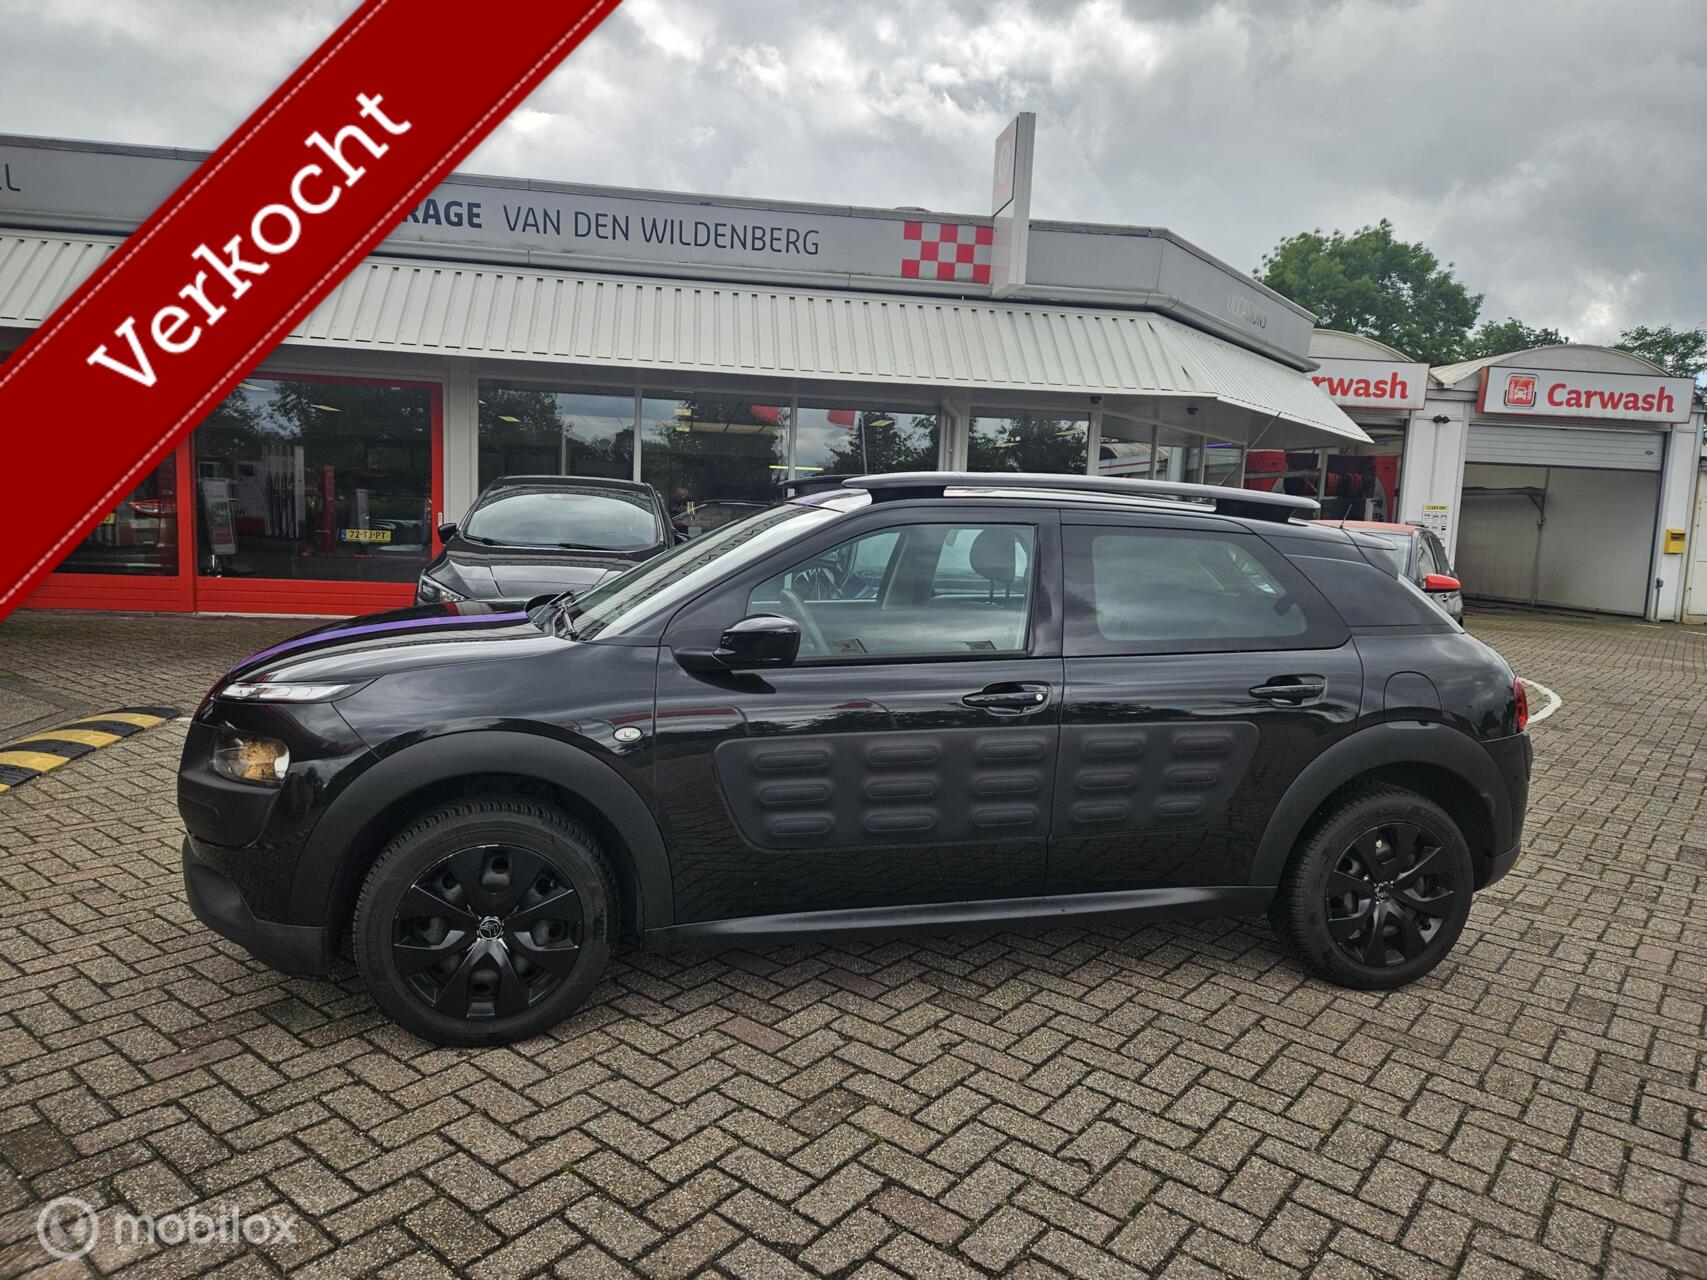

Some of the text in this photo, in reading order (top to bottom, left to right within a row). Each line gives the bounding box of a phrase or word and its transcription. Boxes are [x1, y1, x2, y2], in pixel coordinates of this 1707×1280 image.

[0, 164, 21, 192] L
[503, 204, 561, 235] VAN
[574, 211, 629, 240] DEN
[641, 217, 820, 255] WILDENBERG
[1547, 382, 1675, 413] Carwash
